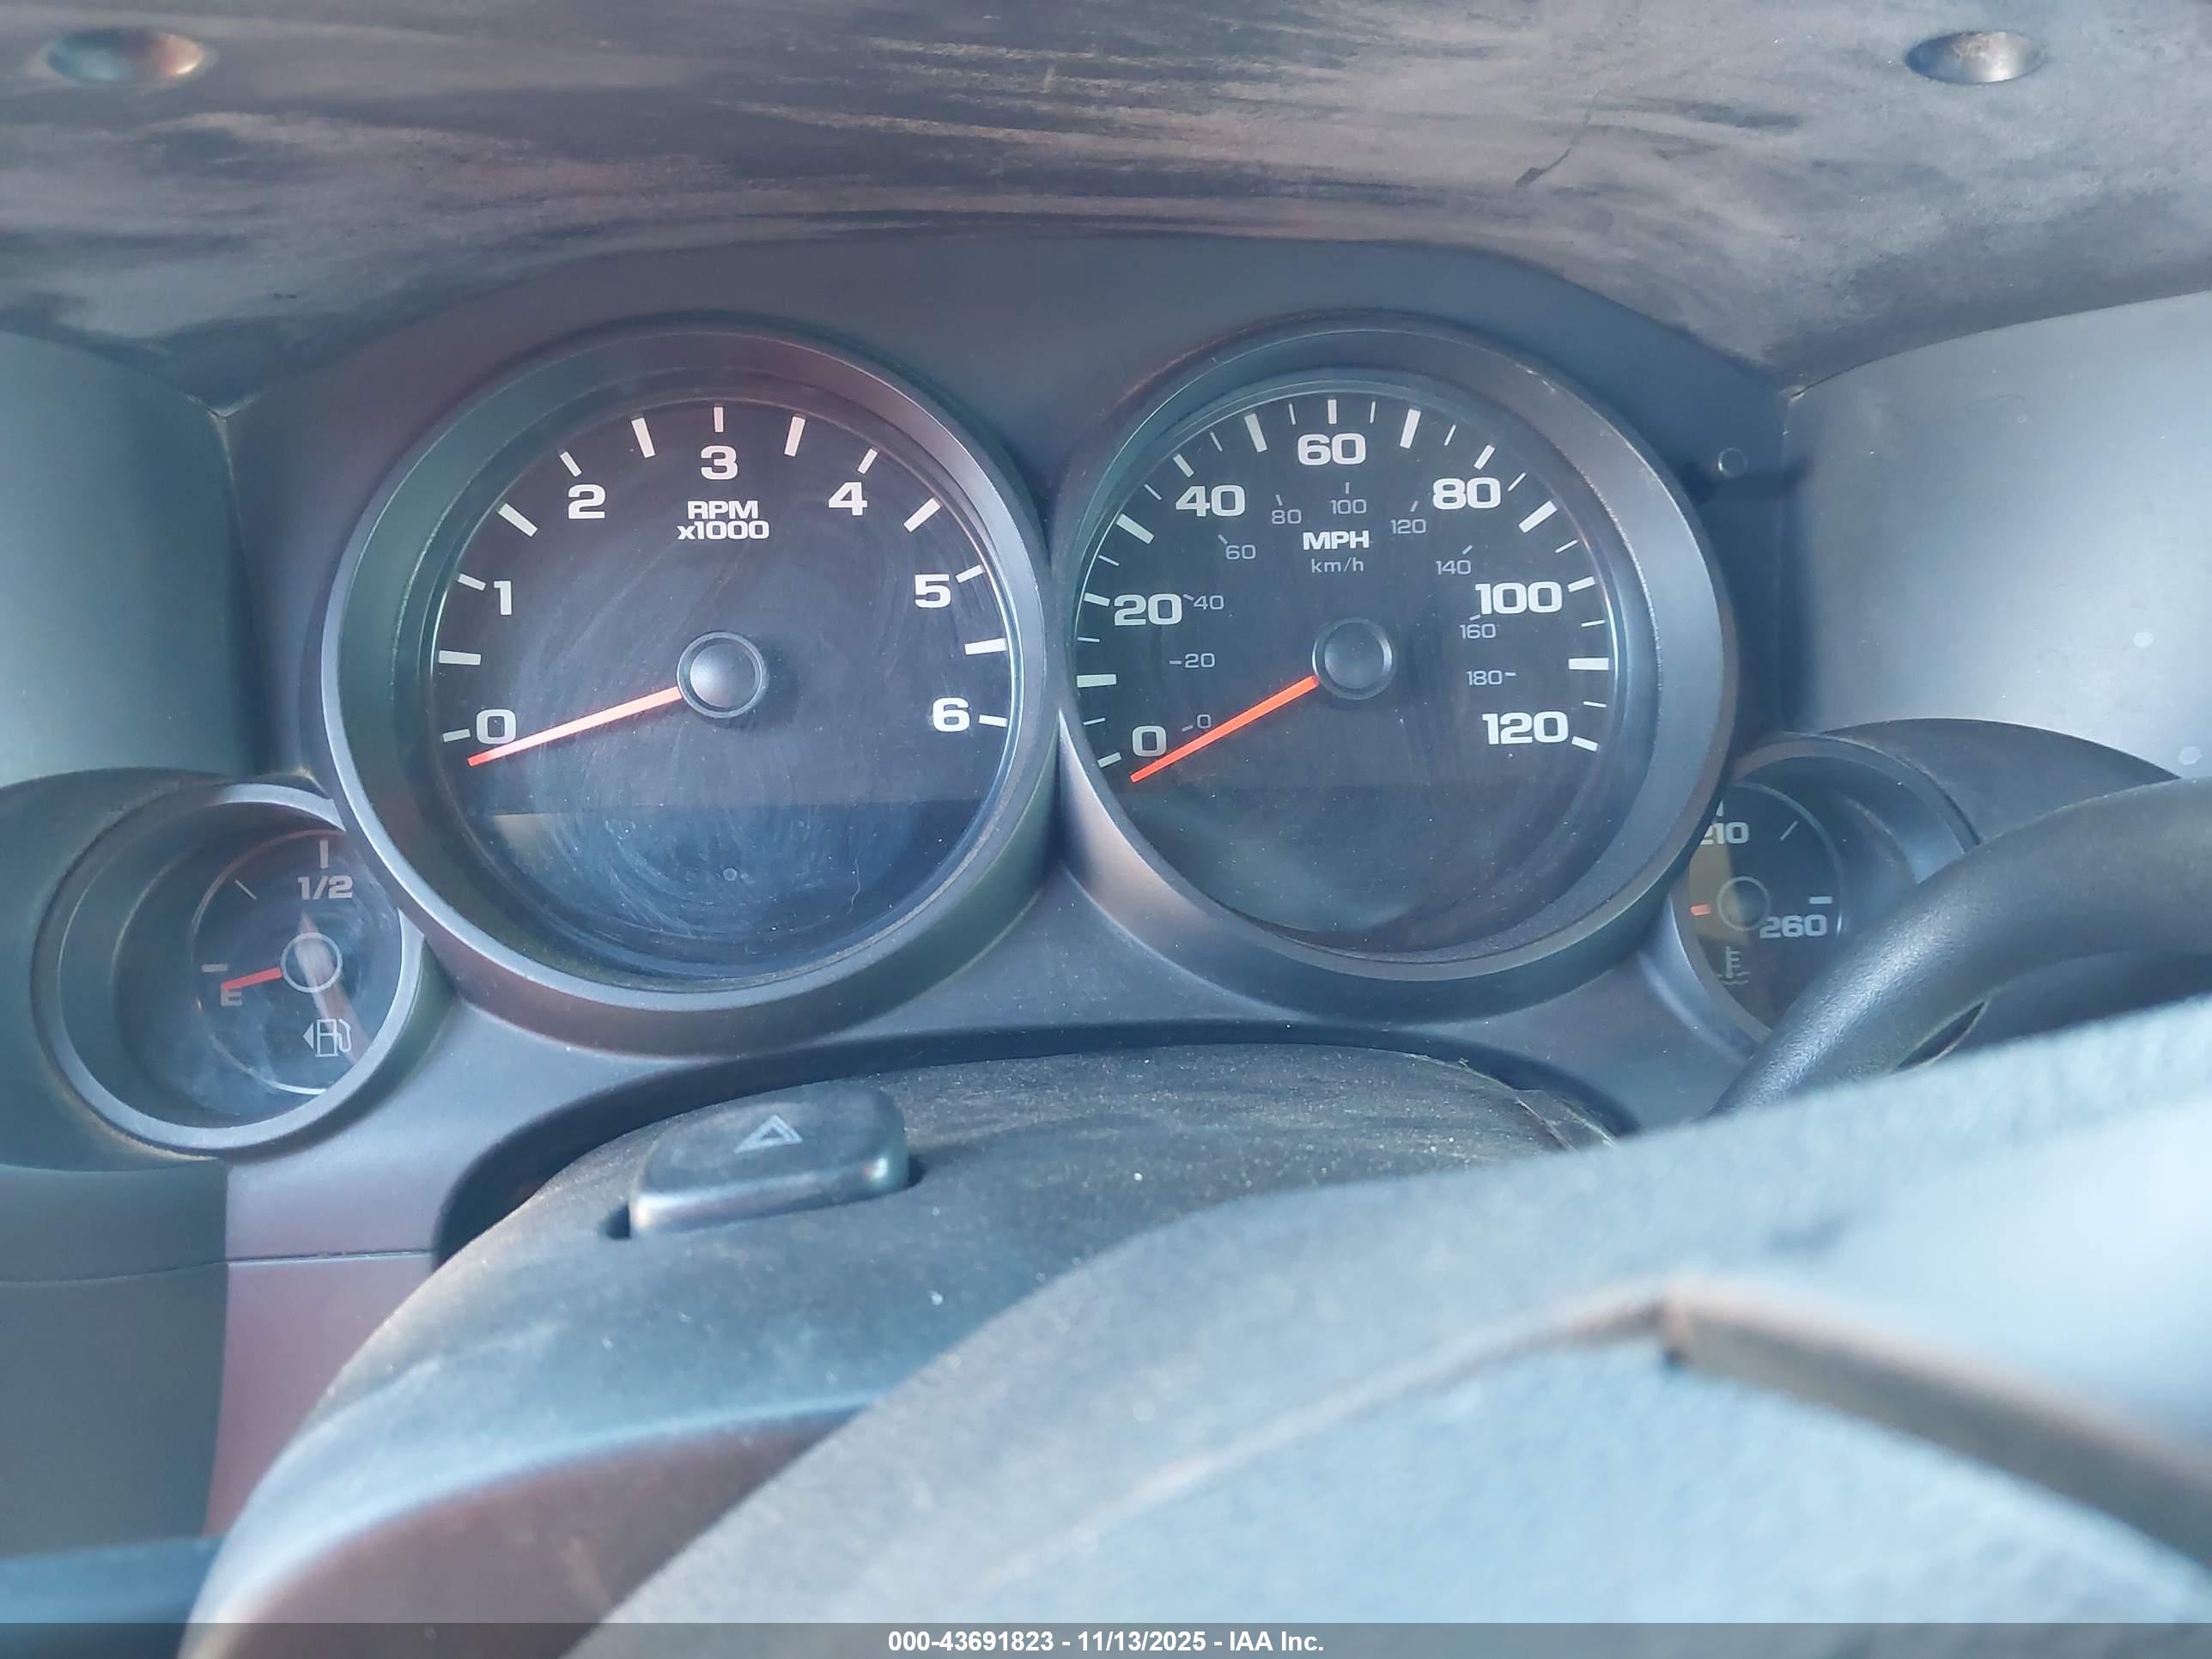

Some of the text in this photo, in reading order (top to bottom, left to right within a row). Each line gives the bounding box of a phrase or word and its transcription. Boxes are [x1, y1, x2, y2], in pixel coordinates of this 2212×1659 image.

[1297, 433, 1367, 465] 60
[700, 445, 738, 480] 3
[568, 483, 606, 520] 2
[828, 482, 867, 516] 4
[1175, 485, 1246, 517] 40
[1432, 477, 1501, 510] 80
[687, 500, 758, 520] RPM
[1271, 509, 1303, 526] 80
[1330, 499, 1367, 515] 100
[677, 520, 769, 540] x1000
[1303, 529, 1370, 550] MPH
[1390, 519, 1427, 535] 120
[1224, 544, 1256, 560] 60
[1310, 557, 1365, 574] km/h
[1435, 559, 1472, 575] 140
[494, 580, 513, 616] 1
[915, 574, 951, 609] 5
[1193, 594, 1224, 611] 40
[1475, 580, 1563, 615] 100
[1114, 592, 1182, 626] 20
[1460, 623, 1497, 639] 160
[1184, 653, 1216, 669] 20
[1466, 670, 1503, 686] 180
[477, 708, 516, 744] 0
[933, 697, 970, 732] 6
[1196, 714, 1212, 730] 0
[1481, 711, 1569, 744] 120
[1132, 725, 1167, 757] 0
[297, 874, 354, 901] 1/2
[1760, 914, 1828, 939] 260
[220, 987, 243, 1007] E
